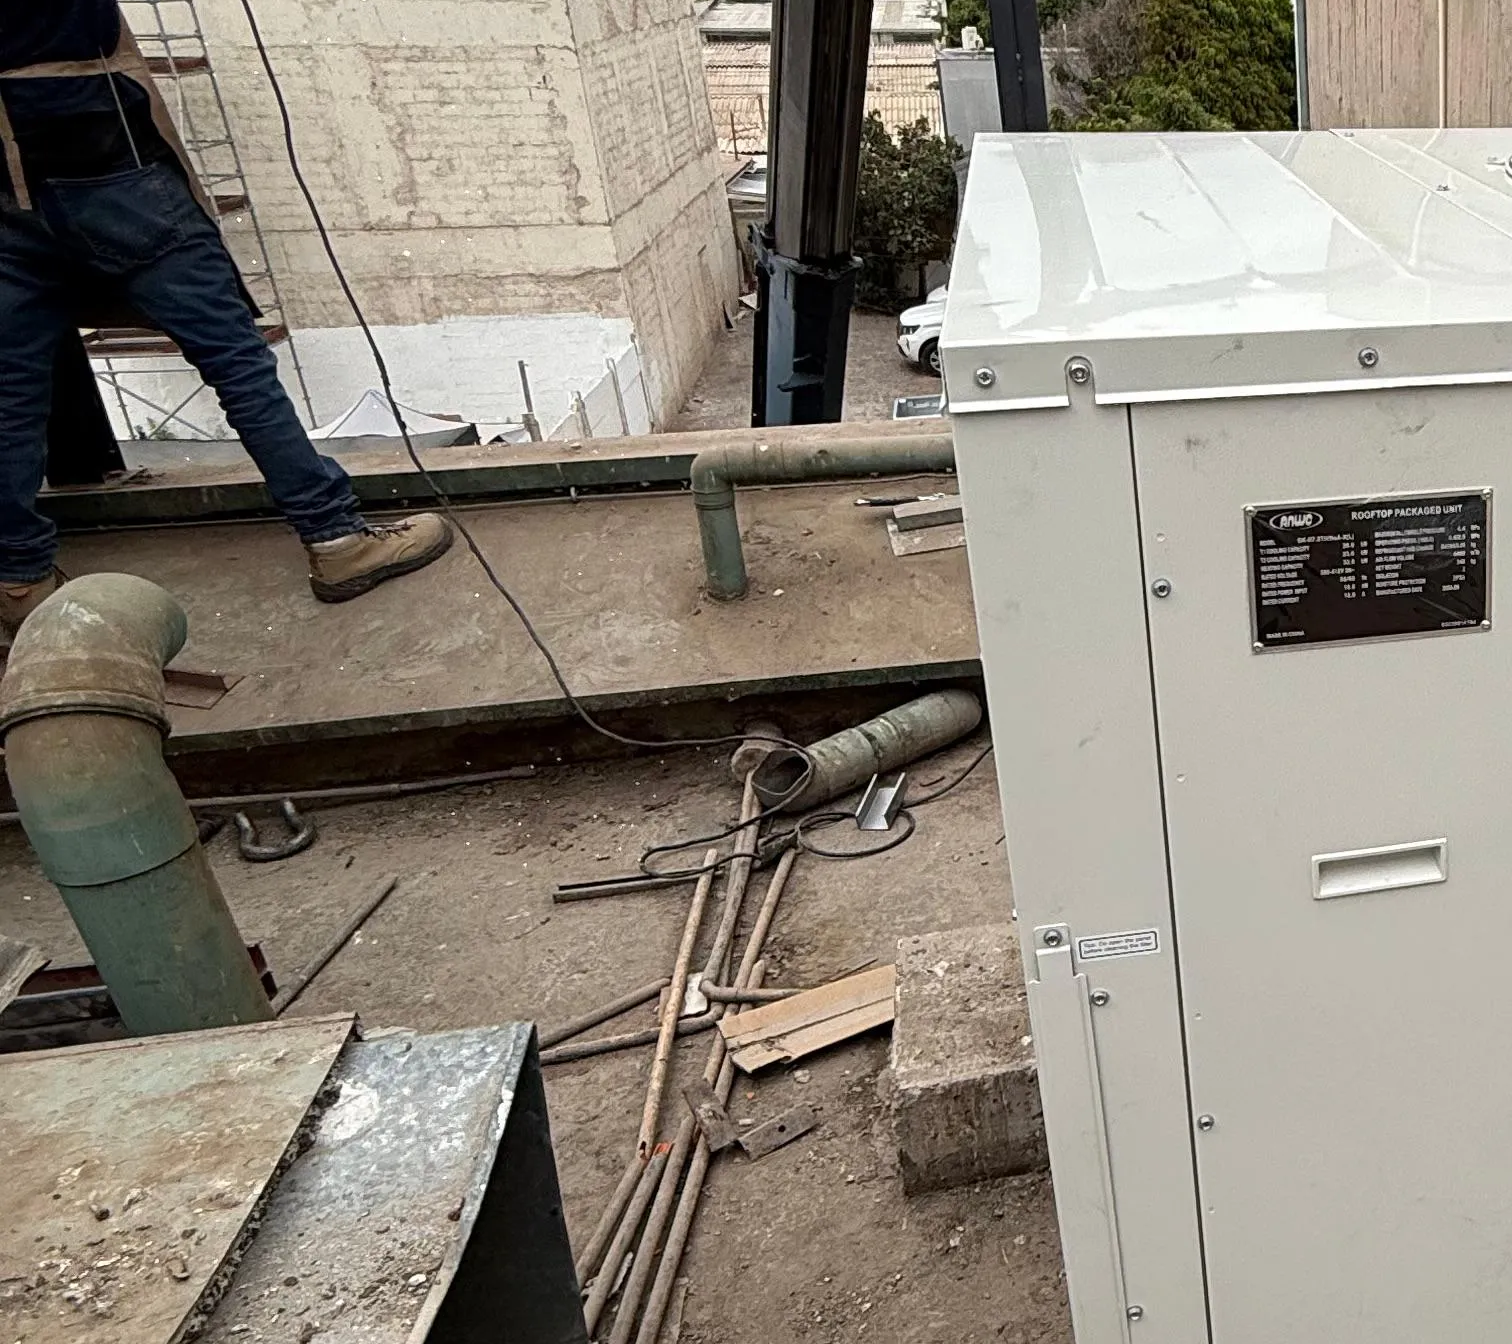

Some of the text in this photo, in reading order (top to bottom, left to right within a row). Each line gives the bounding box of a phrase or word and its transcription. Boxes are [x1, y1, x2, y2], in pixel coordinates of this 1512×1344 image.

[1351, 504, 1463, 520] ROOFTOP PACKAGED UNIT
